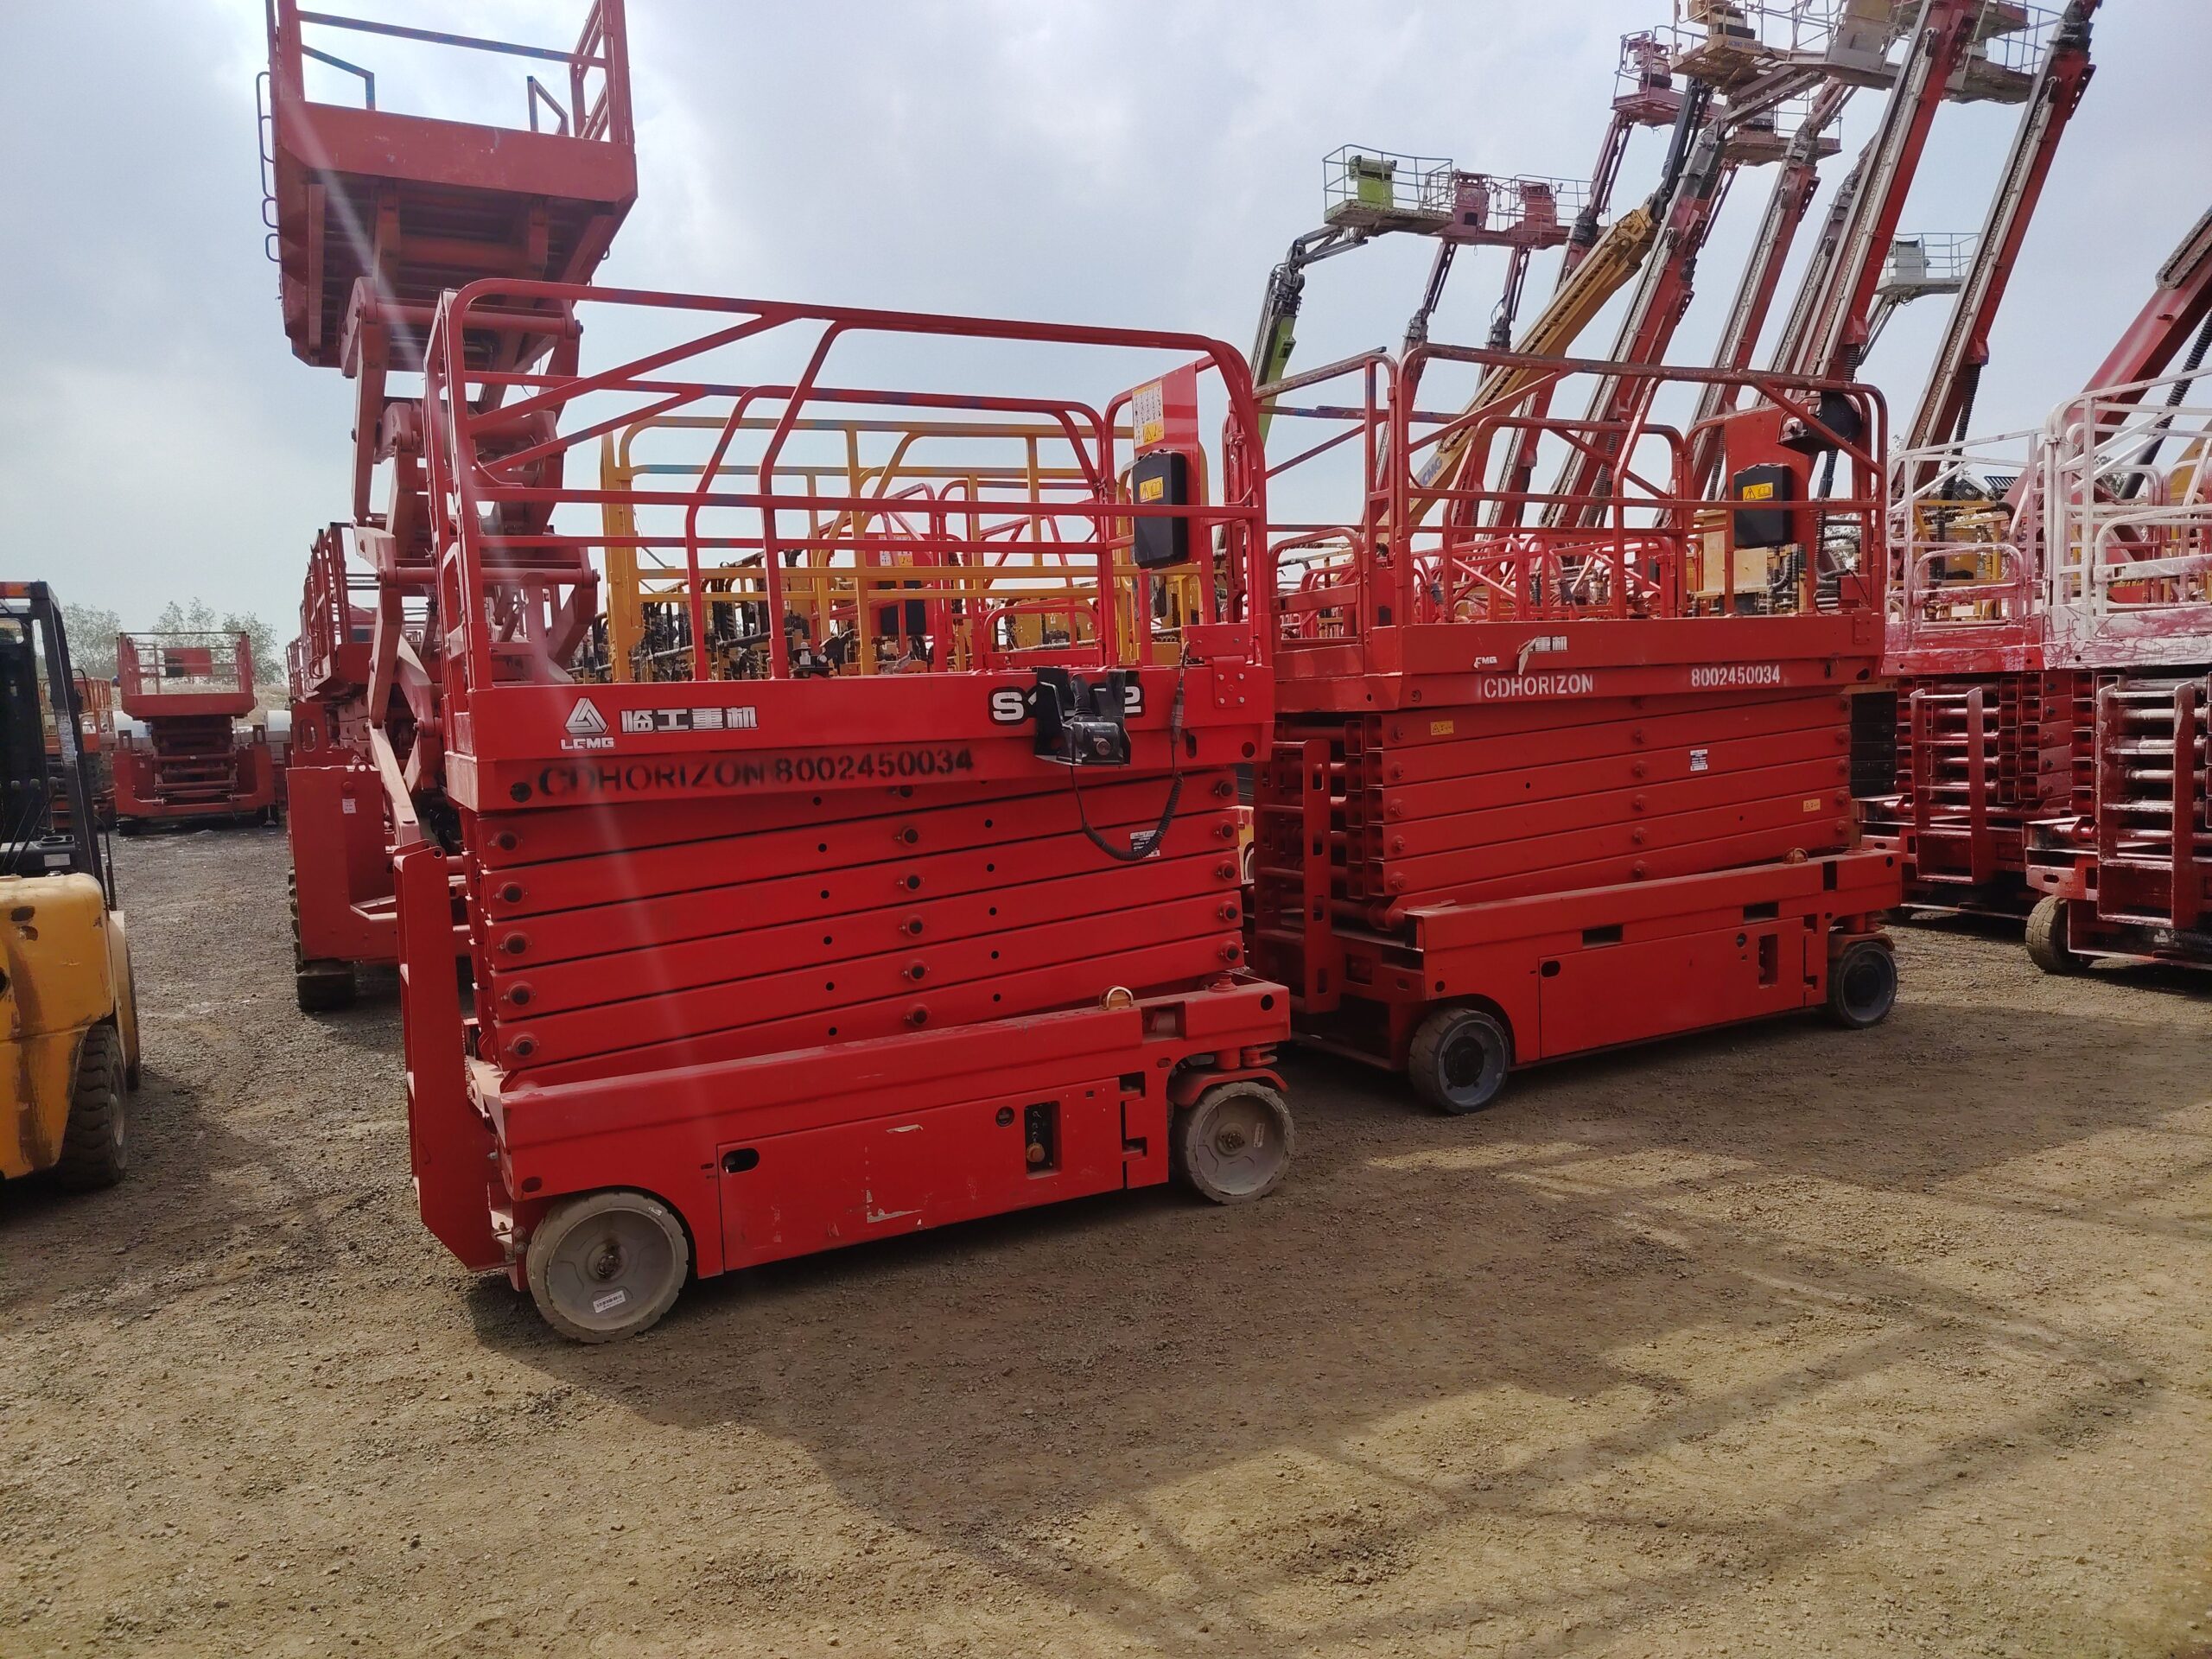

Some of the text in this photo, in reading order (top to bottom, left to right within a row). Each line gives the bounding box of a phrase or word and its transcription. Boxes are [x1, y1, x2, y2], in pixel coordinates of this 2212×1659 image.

[1420, 456, 1443, 486] CMG
[1484, 664, 1780, 699] CDHORIZON 8002450034
[620, 706, 759, 733] 临工重机
[538, 747, 974, 797] CDHORIZON 8002450034
